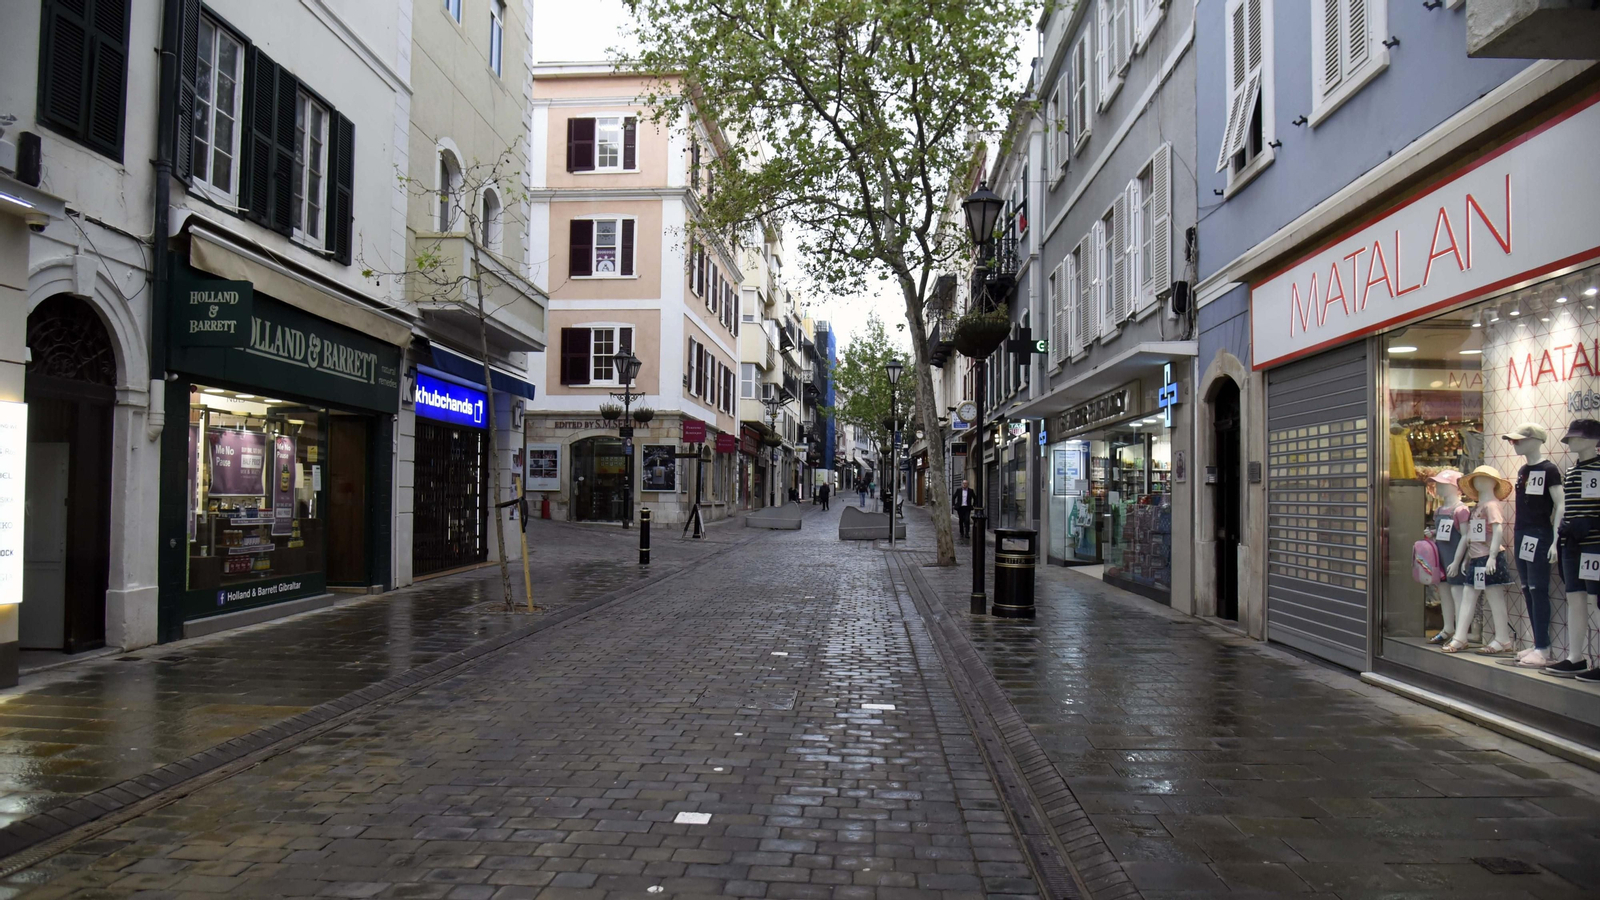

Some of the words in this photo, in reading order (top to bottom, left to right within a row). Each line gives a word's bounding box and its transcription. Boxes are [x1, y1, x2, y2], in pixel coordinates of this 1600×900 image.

[1290, 173, 1513, 338] MATALAN
[189, 291, 239, 304] HOLLAND
[208, 304, 219, 318] &
[189, 320, 237, 333] BARRETT
[307, 333, 321, 368] &
[322, 339, 378, 385] BARRETT
[415, 384, 474, 415] khubchands
[1567, 389, 1600, 413] Kids
[554, 421, 583, 429] EDITED
[584, 421, 594, 429] BY
[215, 445, 225, 454] Me
[225, 445, 235, 456] No
[277, 451, 289, 460] Pause
[216, 457, 231, 467] Pause
[227, 590, 251, 602] Holland
[251, 588, 257, 598] &
[257, 584, 278, 597] Barrett
[278, 581, 302, 593] Gibraltar
